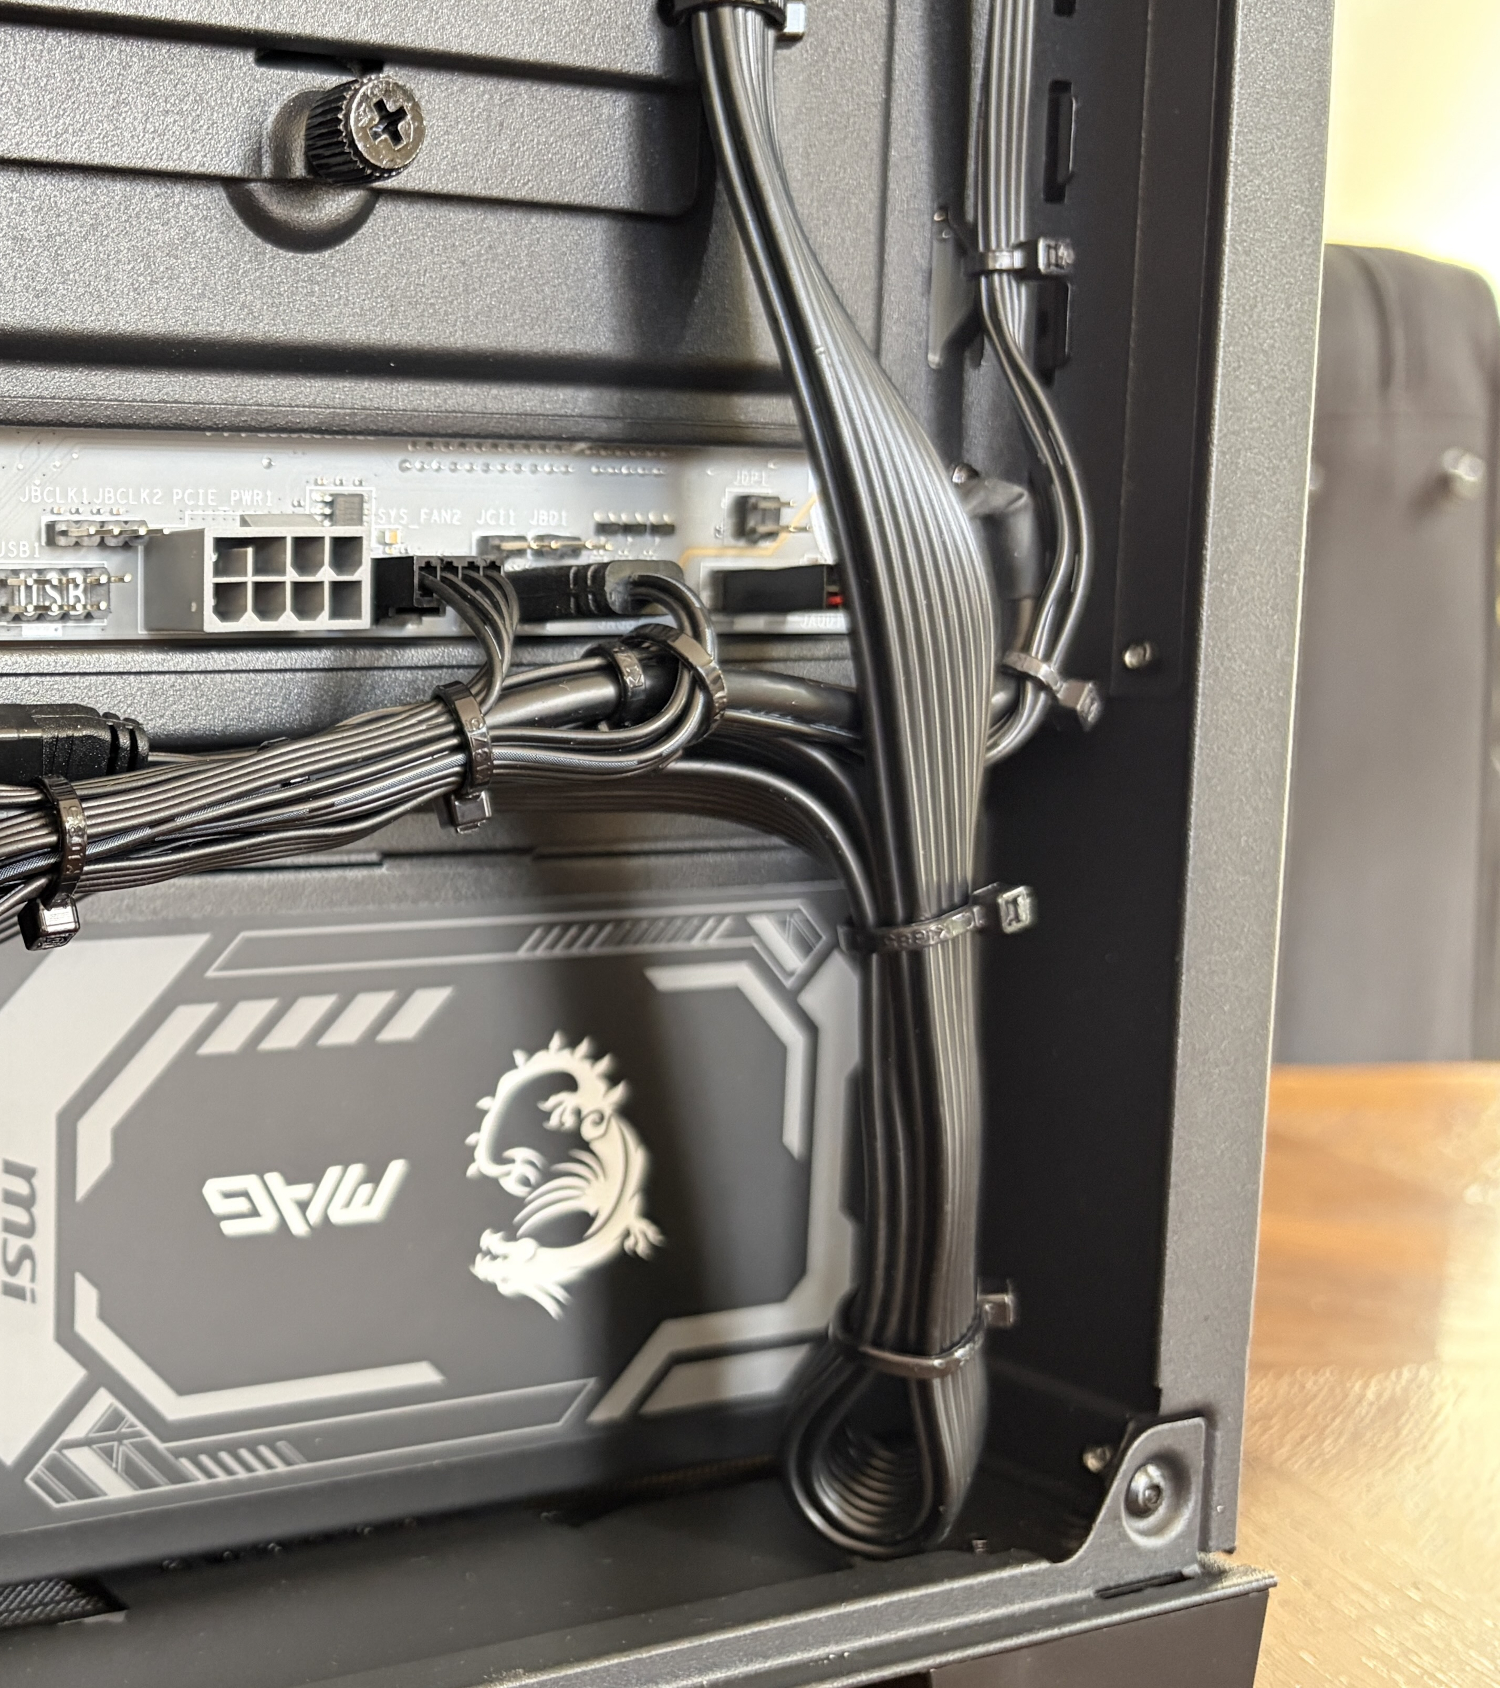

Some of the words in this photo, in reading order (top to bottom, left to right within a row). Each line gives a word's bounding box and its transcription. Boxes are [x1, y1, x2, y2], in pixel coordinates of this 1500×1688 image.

[19, 486, 88, 504] JBCLK1
[93, 487, 163, 505] JBCLK2
[377, 508, 462, 529] SYS_FAN2
[202, 1158, 410, 1239] MAG
[0, 1157, 38, 1305] msi
